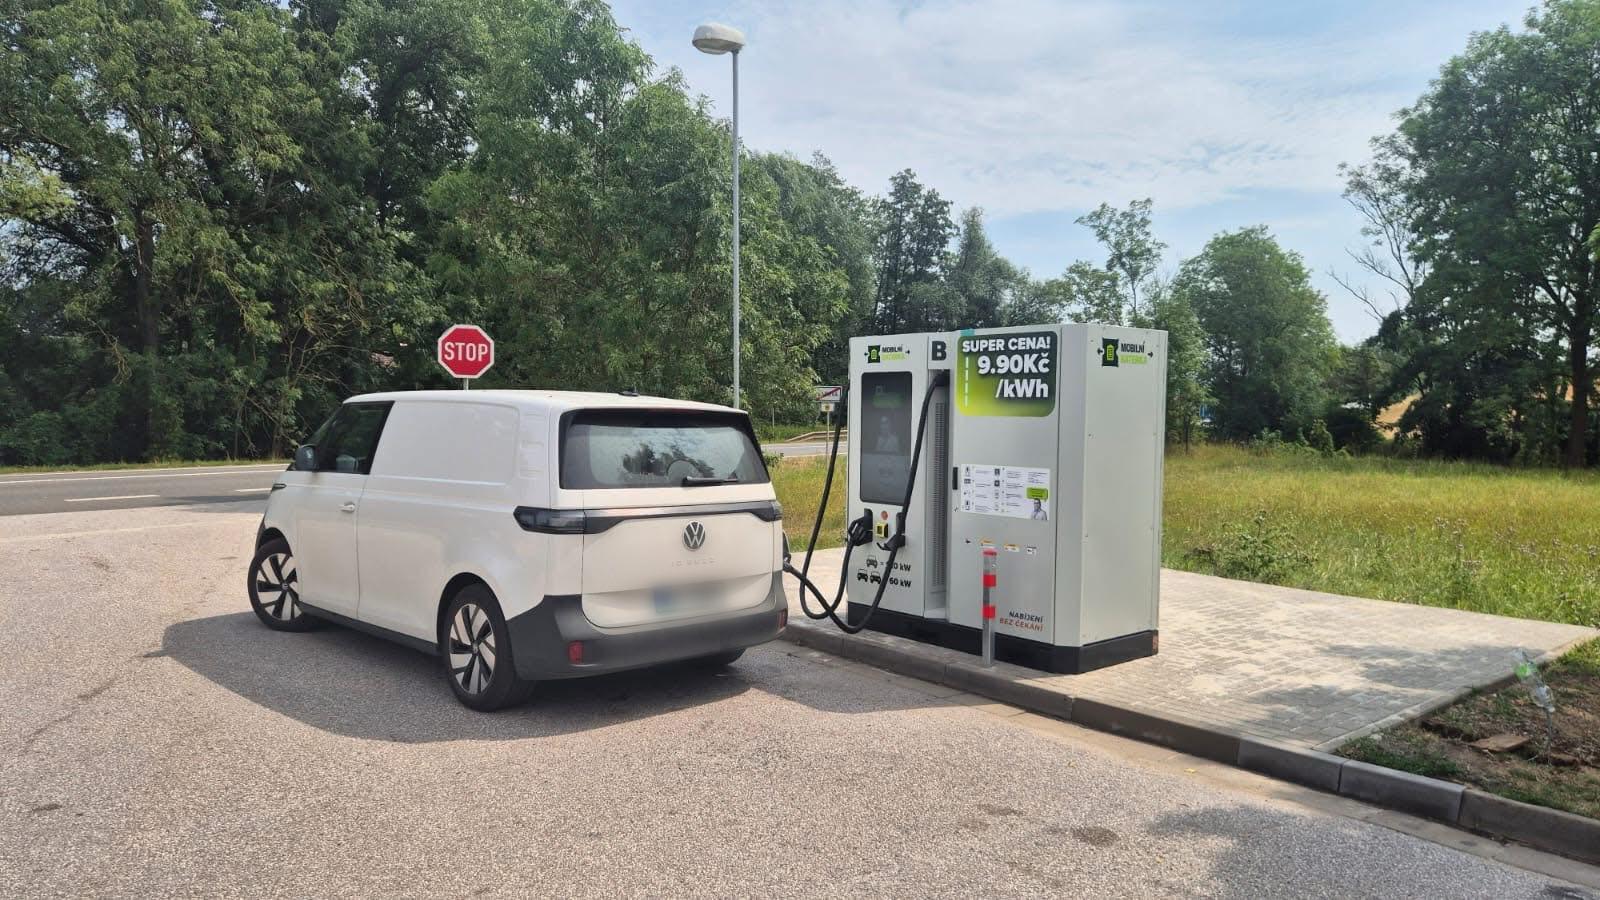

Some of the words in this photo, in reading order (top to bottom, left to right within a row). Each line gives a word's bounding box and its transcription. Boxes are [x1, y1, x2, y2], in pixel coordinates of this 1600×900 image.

[444, 341, 488, 362] STOP
[932, 340, 947, 361] B
[962, 338, 1005, 352] SUPER
[1007, 336, 1051, 350] CENA!
[977, 352, 1050, 375] 9.90Kč
[995, 378, 1049, 398] /kWh
[900, 562, 911, 572] kW
[900, 579, 912, 588] kW
